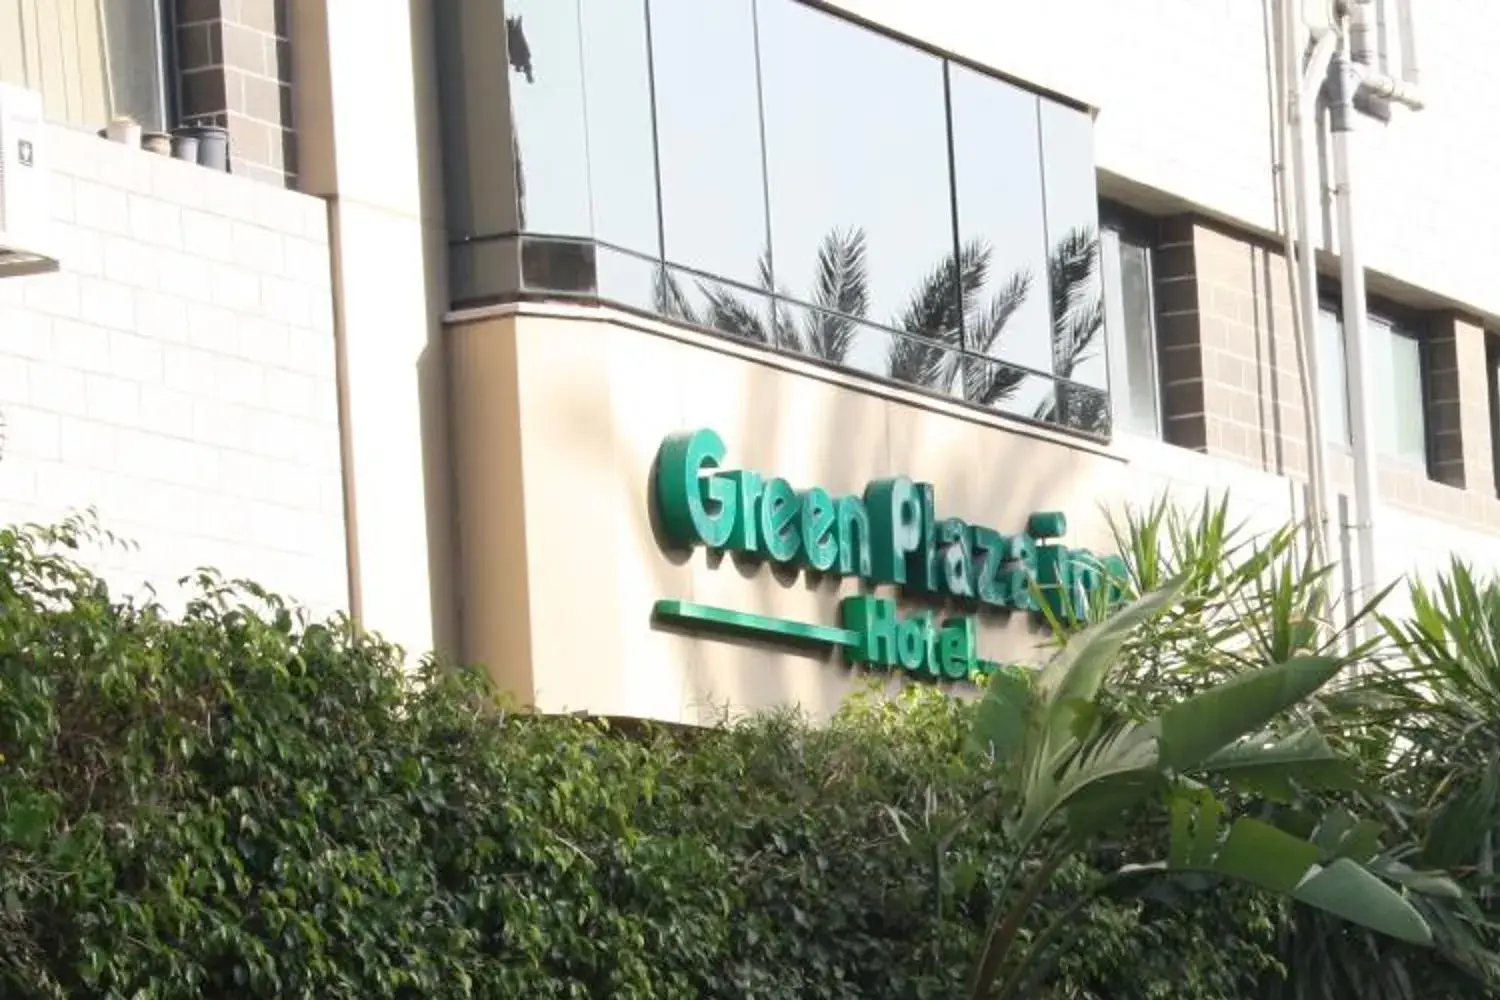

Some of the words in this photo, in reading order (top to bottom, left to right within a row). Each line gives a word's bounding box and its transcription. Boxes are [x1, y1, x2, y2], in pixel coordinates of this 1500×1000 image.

[655, 427, 872, 579] Green
[863, 474, 1040, 613] Plaza
[839, 593, 977, 681] Hotel
